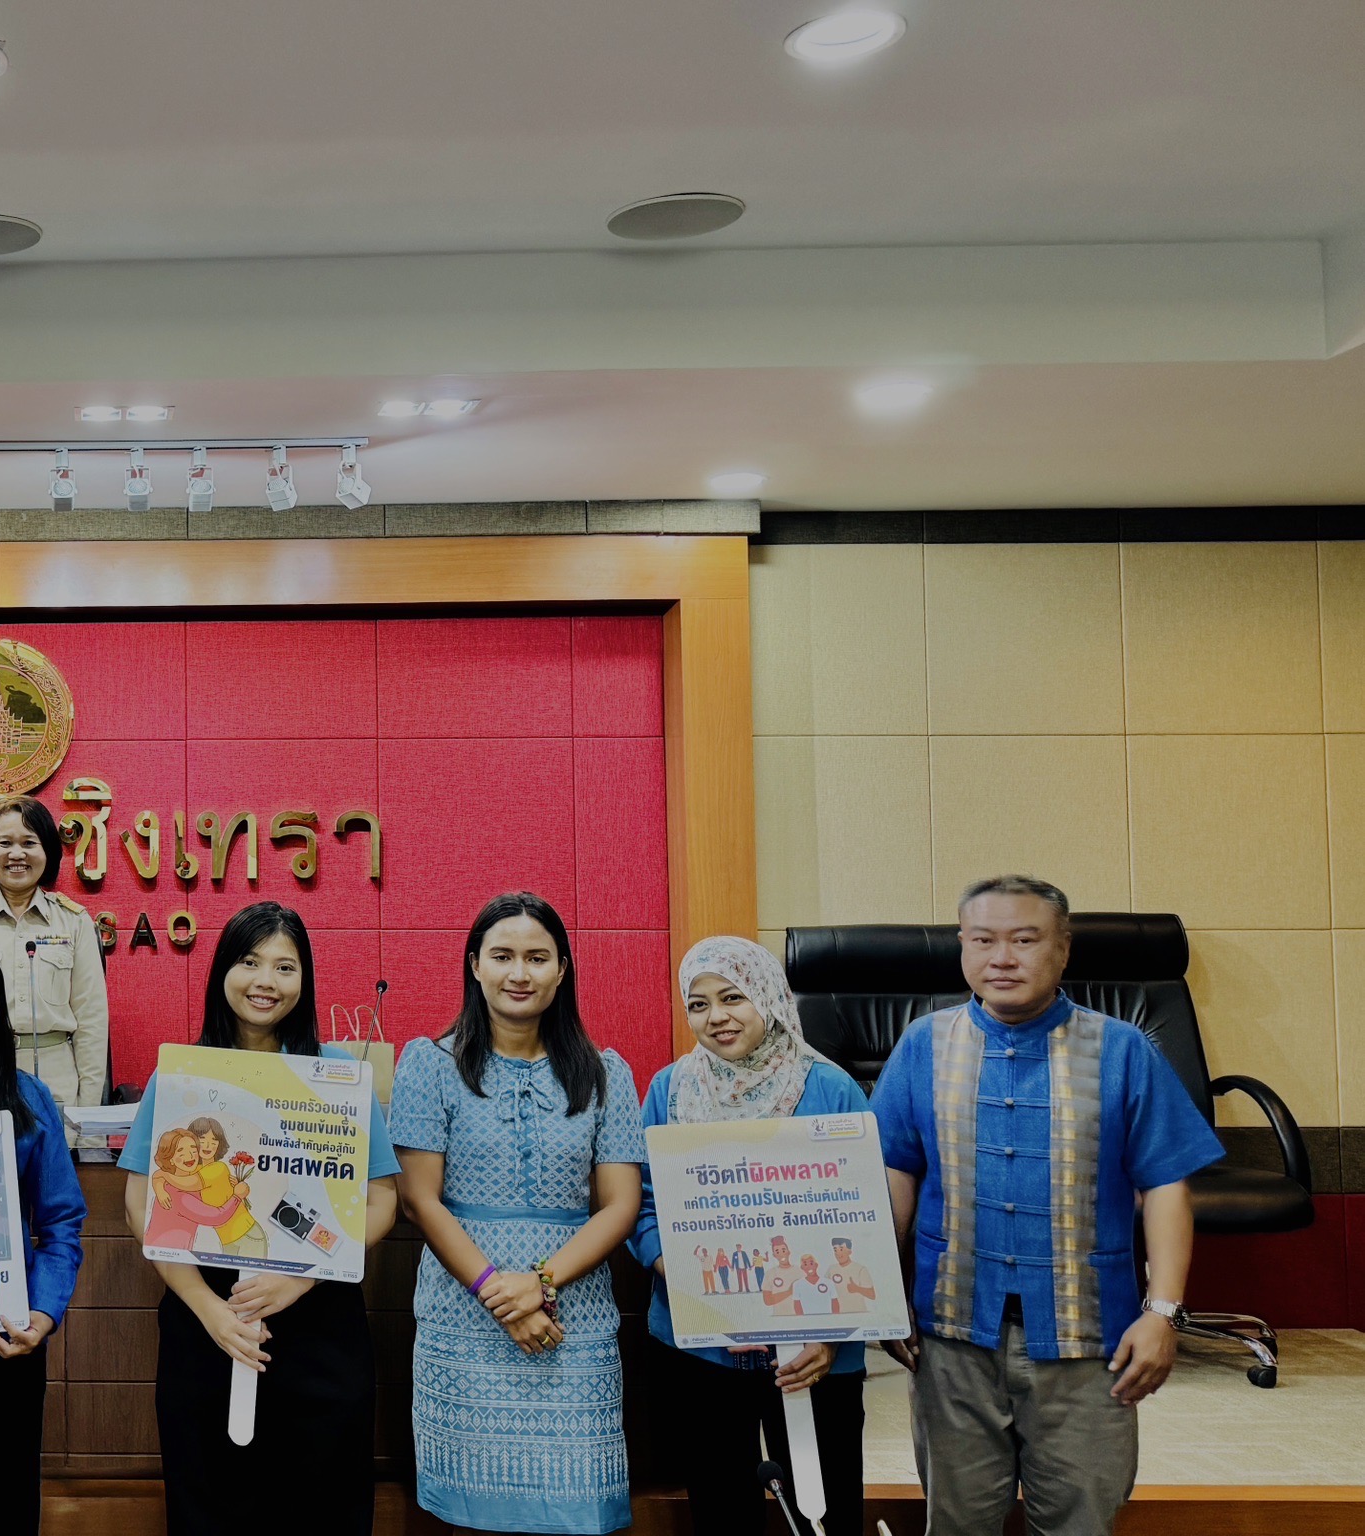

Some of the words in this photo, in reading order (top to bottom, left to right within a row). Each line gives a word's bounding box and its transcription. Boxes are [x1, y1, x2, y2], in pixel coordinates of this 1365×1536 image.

[265, 1098, 357, 1121] ครอบครัวอบอุ่น
[280, 1119, 356, 1137] ชุมชนเข้มแข็ง
[259, 1133, 356, 1157] เป็นพลังสำคัญต่อสู้กับ
[257, 1154, 355, 1181] ยาเสพติด
[684, 1187, 860, 1210] แค่กล้ายอมรับและเริ่มต้นใหม่
[672, 1213, 775, 1233] ครอบครัวให้อภัย
[782, 1208, 877, 1227] สังคมให้โอกาส
